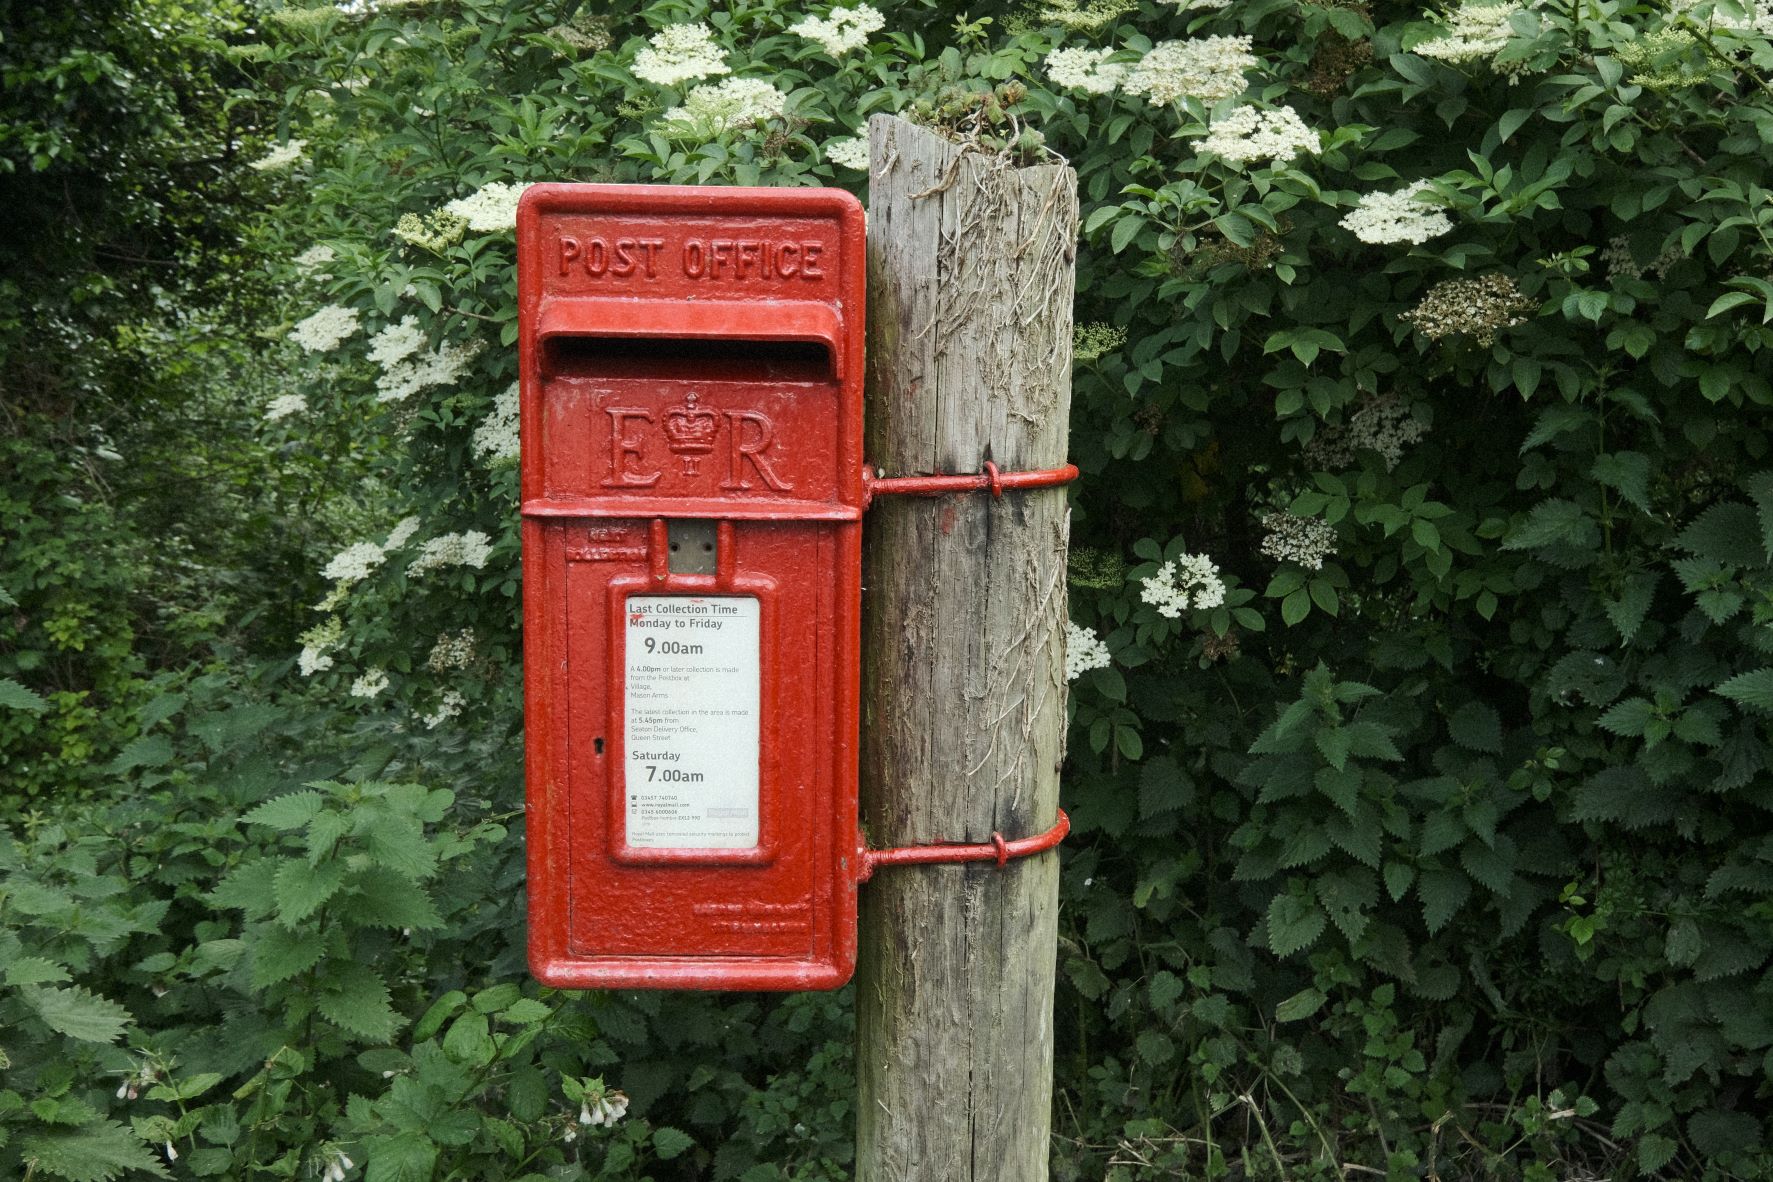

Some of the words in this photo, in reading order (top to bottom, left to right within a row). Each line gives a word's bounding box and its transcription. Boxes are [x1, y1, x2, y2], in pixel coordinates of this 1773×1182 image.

[559, 237, 664, 278] POST
[682, 239, 824, 280] OFFICE
[600, 407, 661, 488] E
[720, 409, 794, 491] R
[629, 604, 652, 614] Last
[656, 604, 708, 614] Collection
[711, 604, 738, 614] Time
[629, 619, 671, 630] Monday
[675, 620, 685, 628] to
[689, 619, 723, 630] Friday
[644, 637, 703, 654] 9.00am
[638, 717, 663, 725] 5.45pm
[653, 726, 678, 734] Delivery
[632, 751, 681, 761] Saturday
[645, 765, 704, 782] 7.00am
